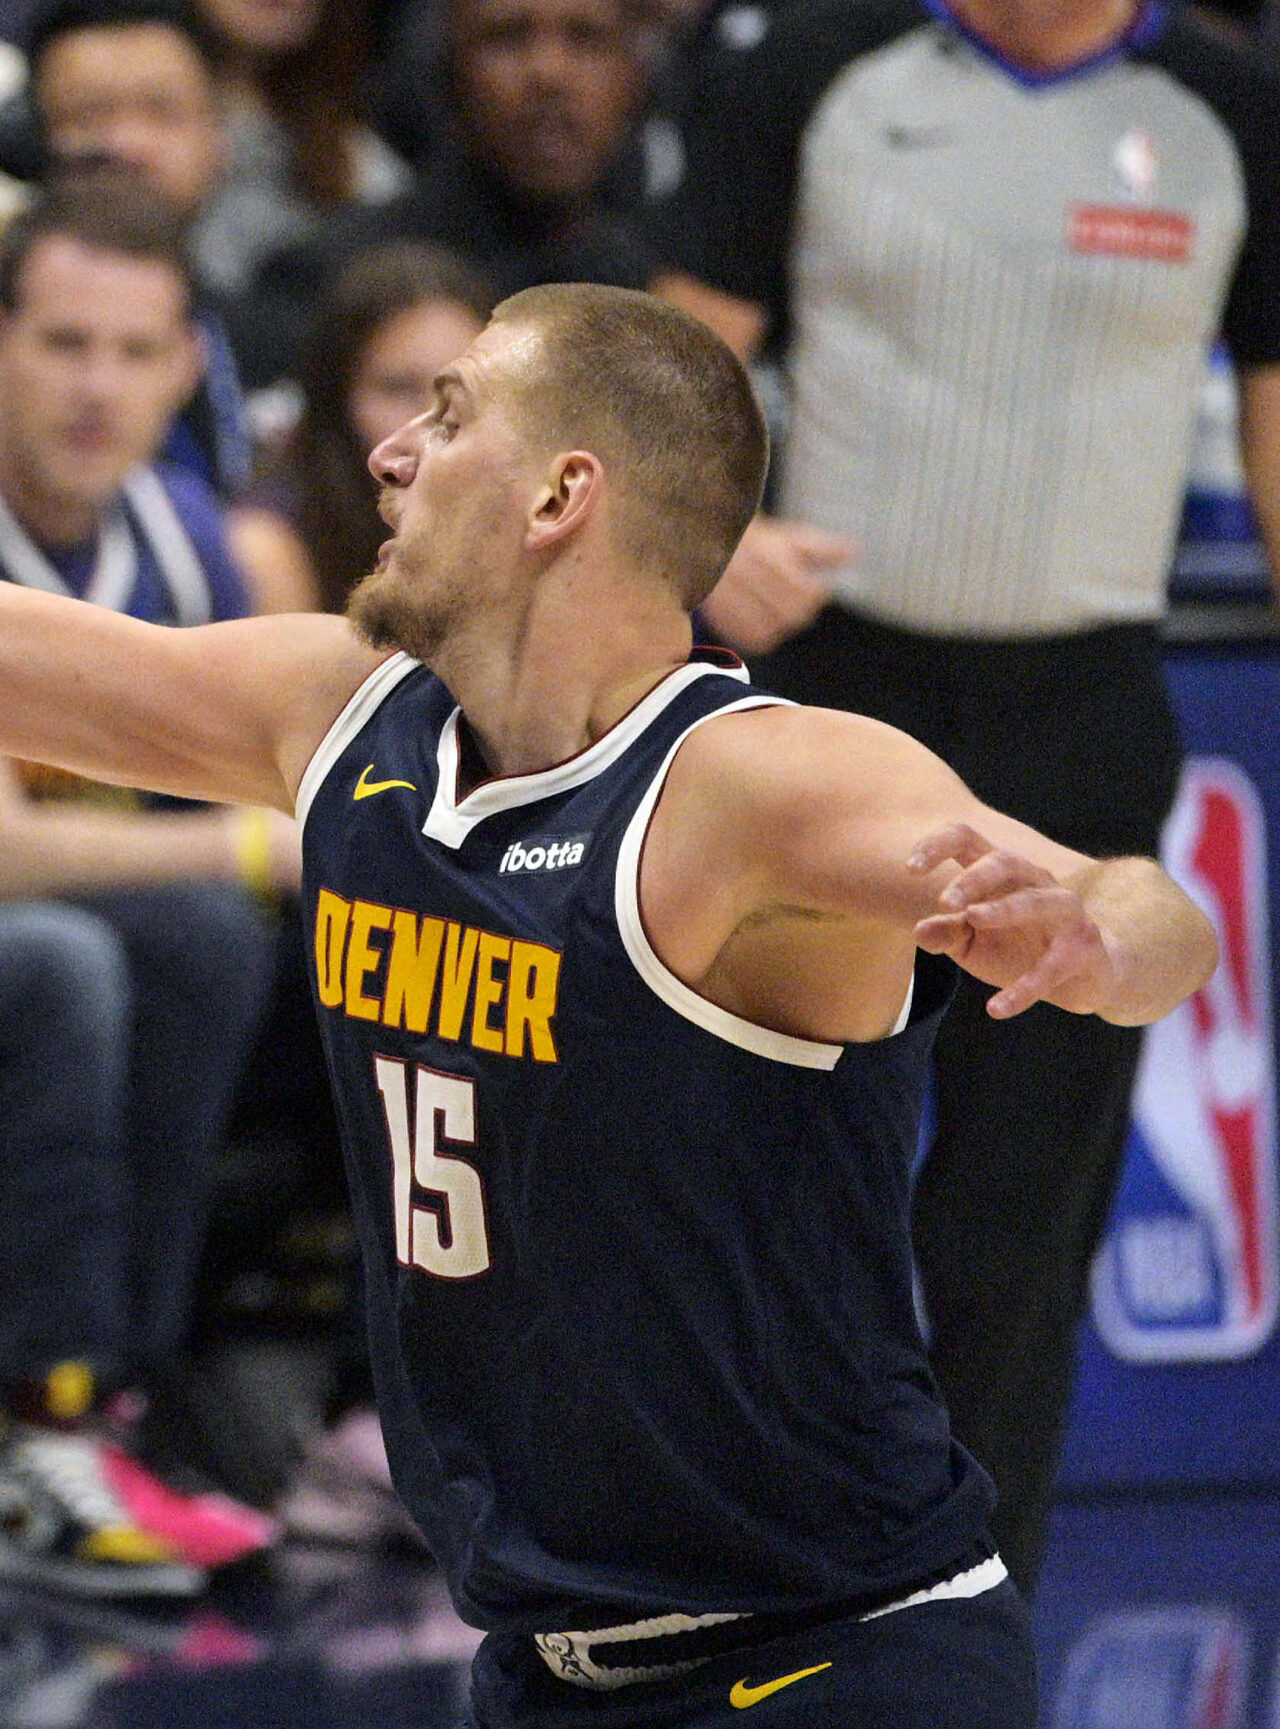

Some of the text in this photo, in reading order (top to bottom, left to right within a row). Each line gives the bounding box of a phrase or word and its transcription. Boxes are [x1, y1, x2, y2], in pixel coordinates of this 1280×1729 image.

[499, 841, 585, 873] ibotta
[314, 886, 563, 1064] DENVER
[373, 1052, 492, 1281] 15
